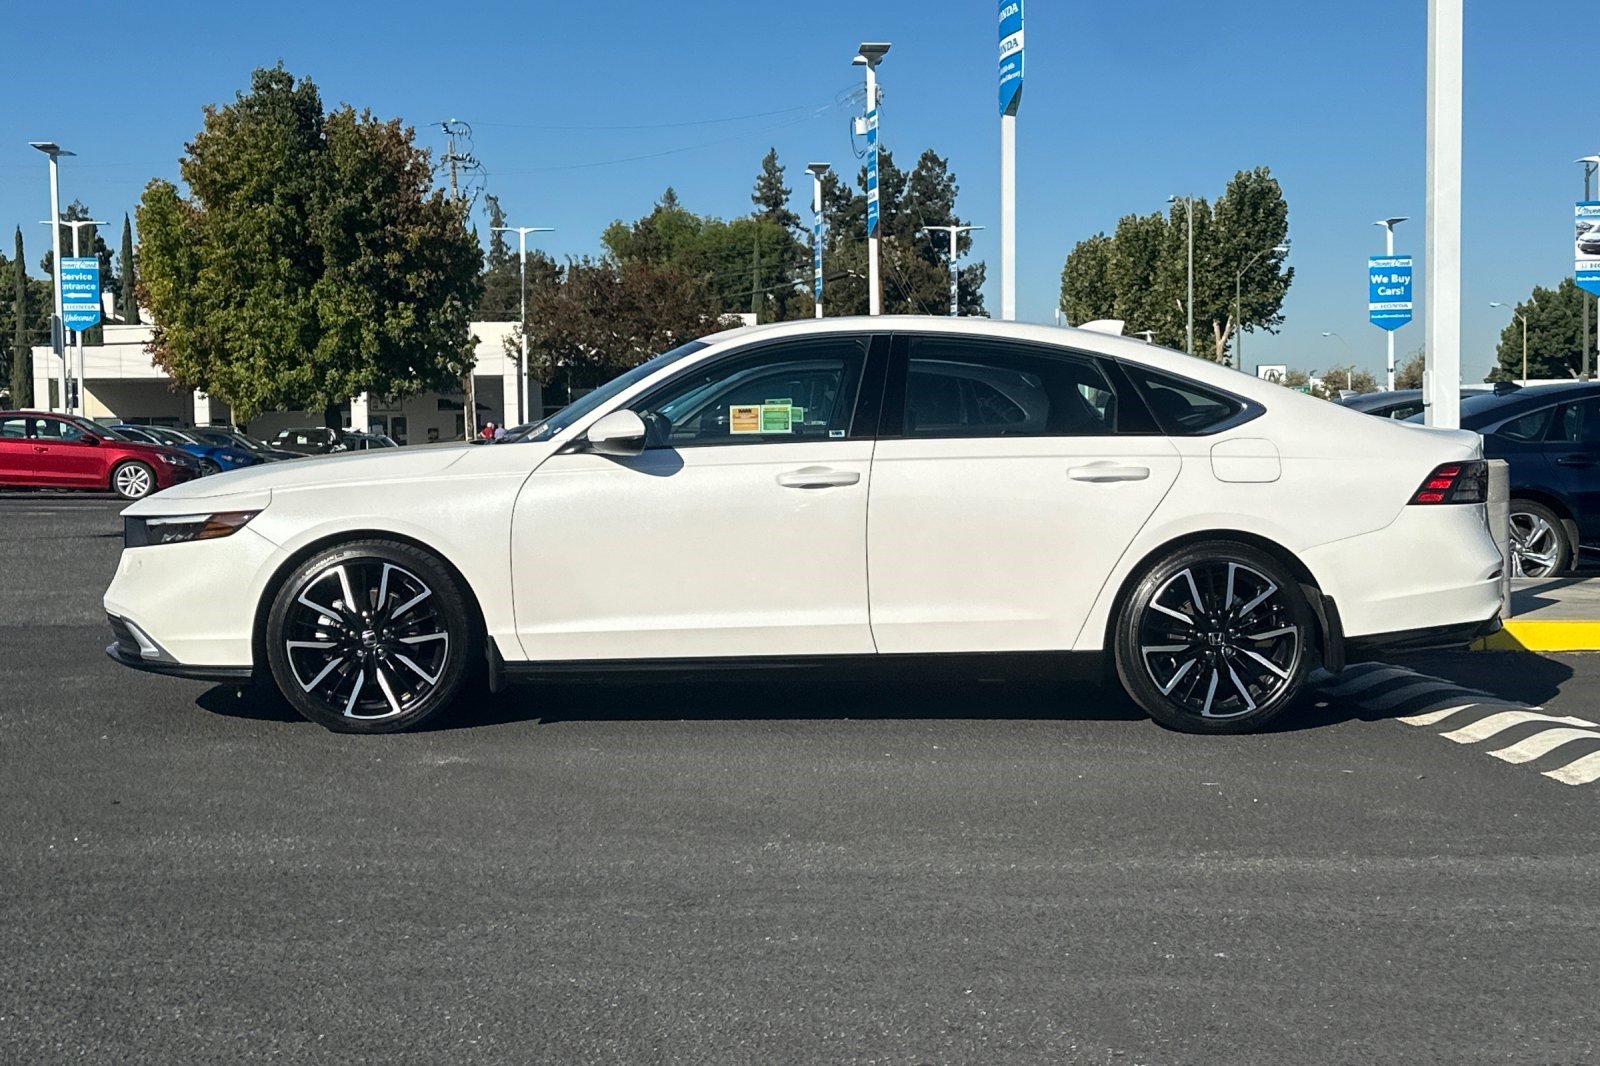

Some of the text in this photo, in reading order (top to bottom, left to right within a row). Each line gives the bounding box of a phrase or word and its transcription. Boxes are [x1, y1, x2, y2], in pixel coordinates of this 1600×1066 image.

[999, 3, 1019, 22] NDA
[1000, 38, 1019, 55] NDA
[61, 272, 93, 280] Service
[1371, 274, 1411, 285] We Buy
[62, 282, 97, 290] ntrance
[1377, 286, 1405, 296] Cars!
